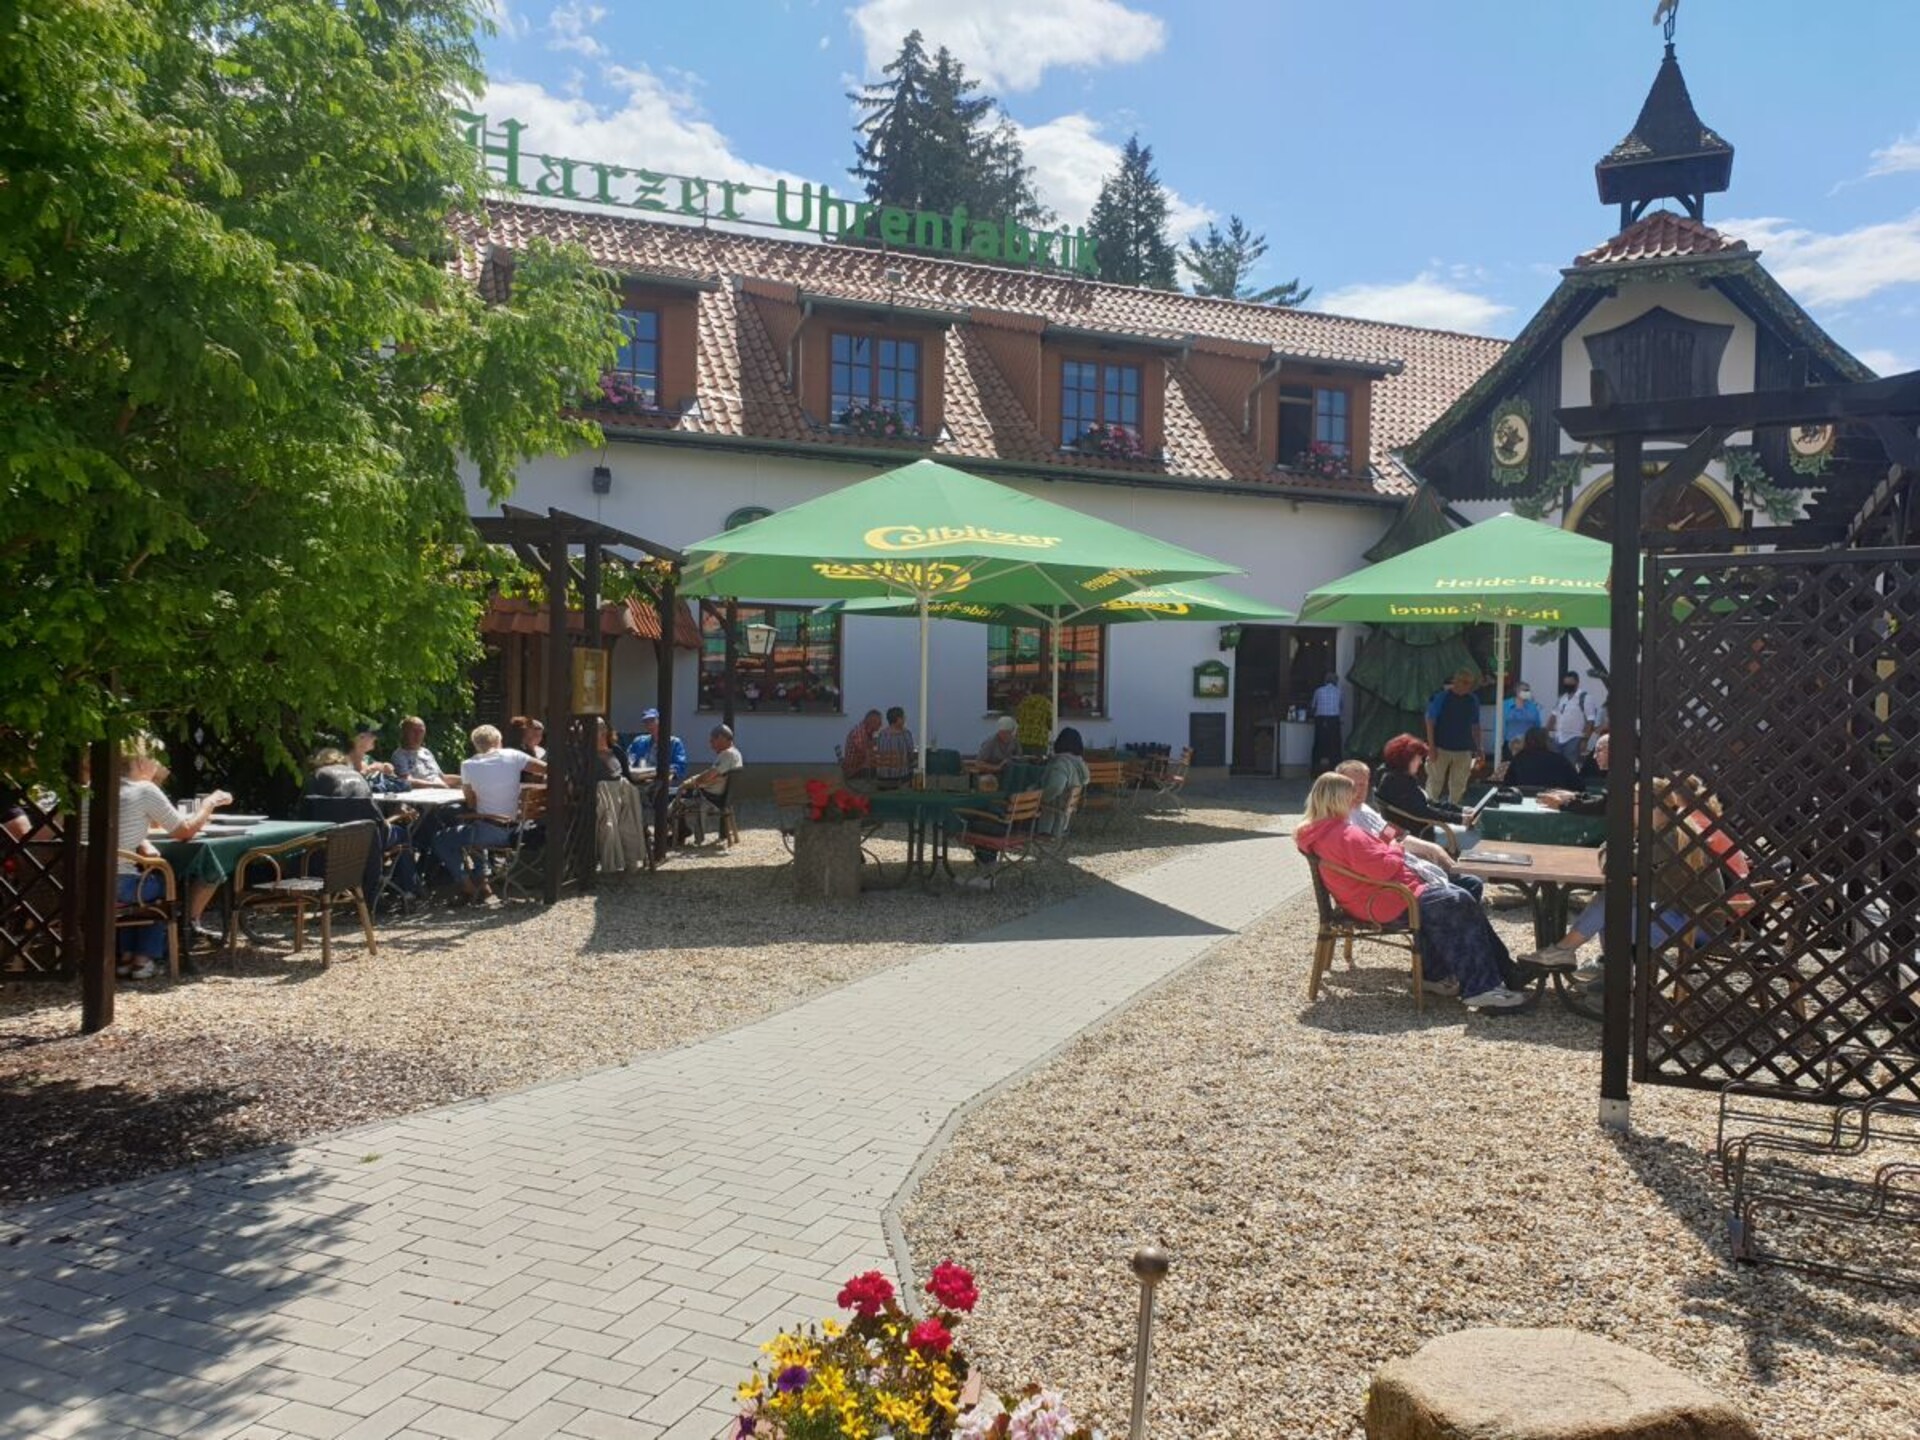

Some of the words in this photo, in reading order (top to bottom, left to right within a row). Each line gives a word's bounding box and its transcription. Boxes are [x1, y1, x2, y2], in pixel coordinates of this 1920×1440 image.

[450, 108, 751, 222] Harzer
[776, 178, 1101, 275] Uhrenfabrik
[863, 525, 1063, 551] Colbitzer
